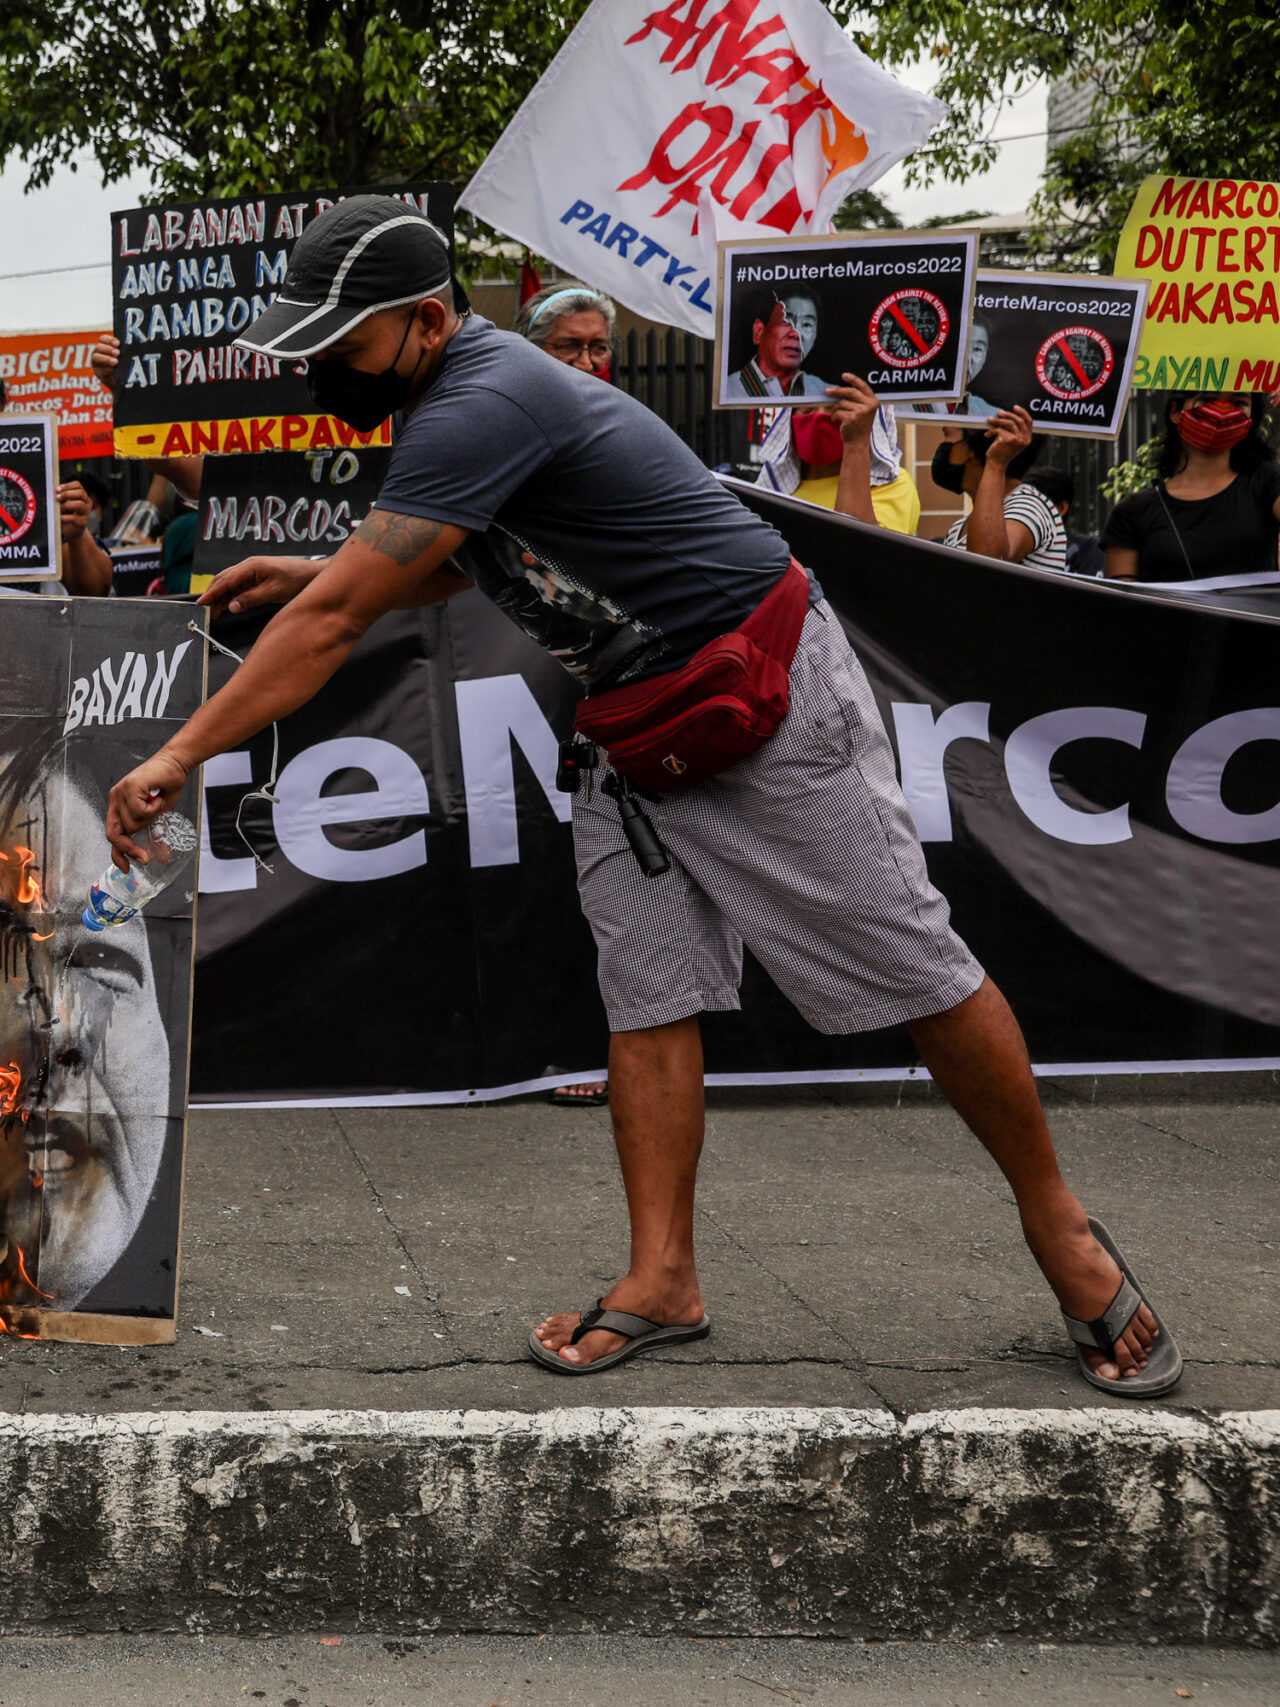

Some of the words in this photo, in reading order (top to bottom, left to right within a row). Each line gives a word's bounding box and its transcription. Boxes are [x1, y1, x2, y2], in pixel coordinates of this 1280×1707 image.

[1149, 177, 1280, 220] MARCO
[120, 200, 266, 257] LABANAN
[273, 203, 309, 239] AT
[1135, 224, 1280, 273] DUTERT
[120, 261, 172, 298] ANG
[177, 254, 236, 292] MGA
[560, 198, 713, 314] PARTY-L
[736, 257, 962, 283] #NoDuterteMarcos2022
[124, 293, 277, 346] RAMBON
[973, 293, 1132, 317] terteMarcos2022
[5, 373, 101, 396] ambalang
[125, 353, 161, 389] AT
[867, 368, 946, 384] CARMMA
[1131, 355, 1229, 391] BAYAN
[1233, 358, 1280, 393] MU
[1029, 398, 1106, 418] CARMMA
[305, 450, 360, 485] TO
[203, 496, 370, 543] MARCOS-
[63, 639, 193, 737] BAYAN
